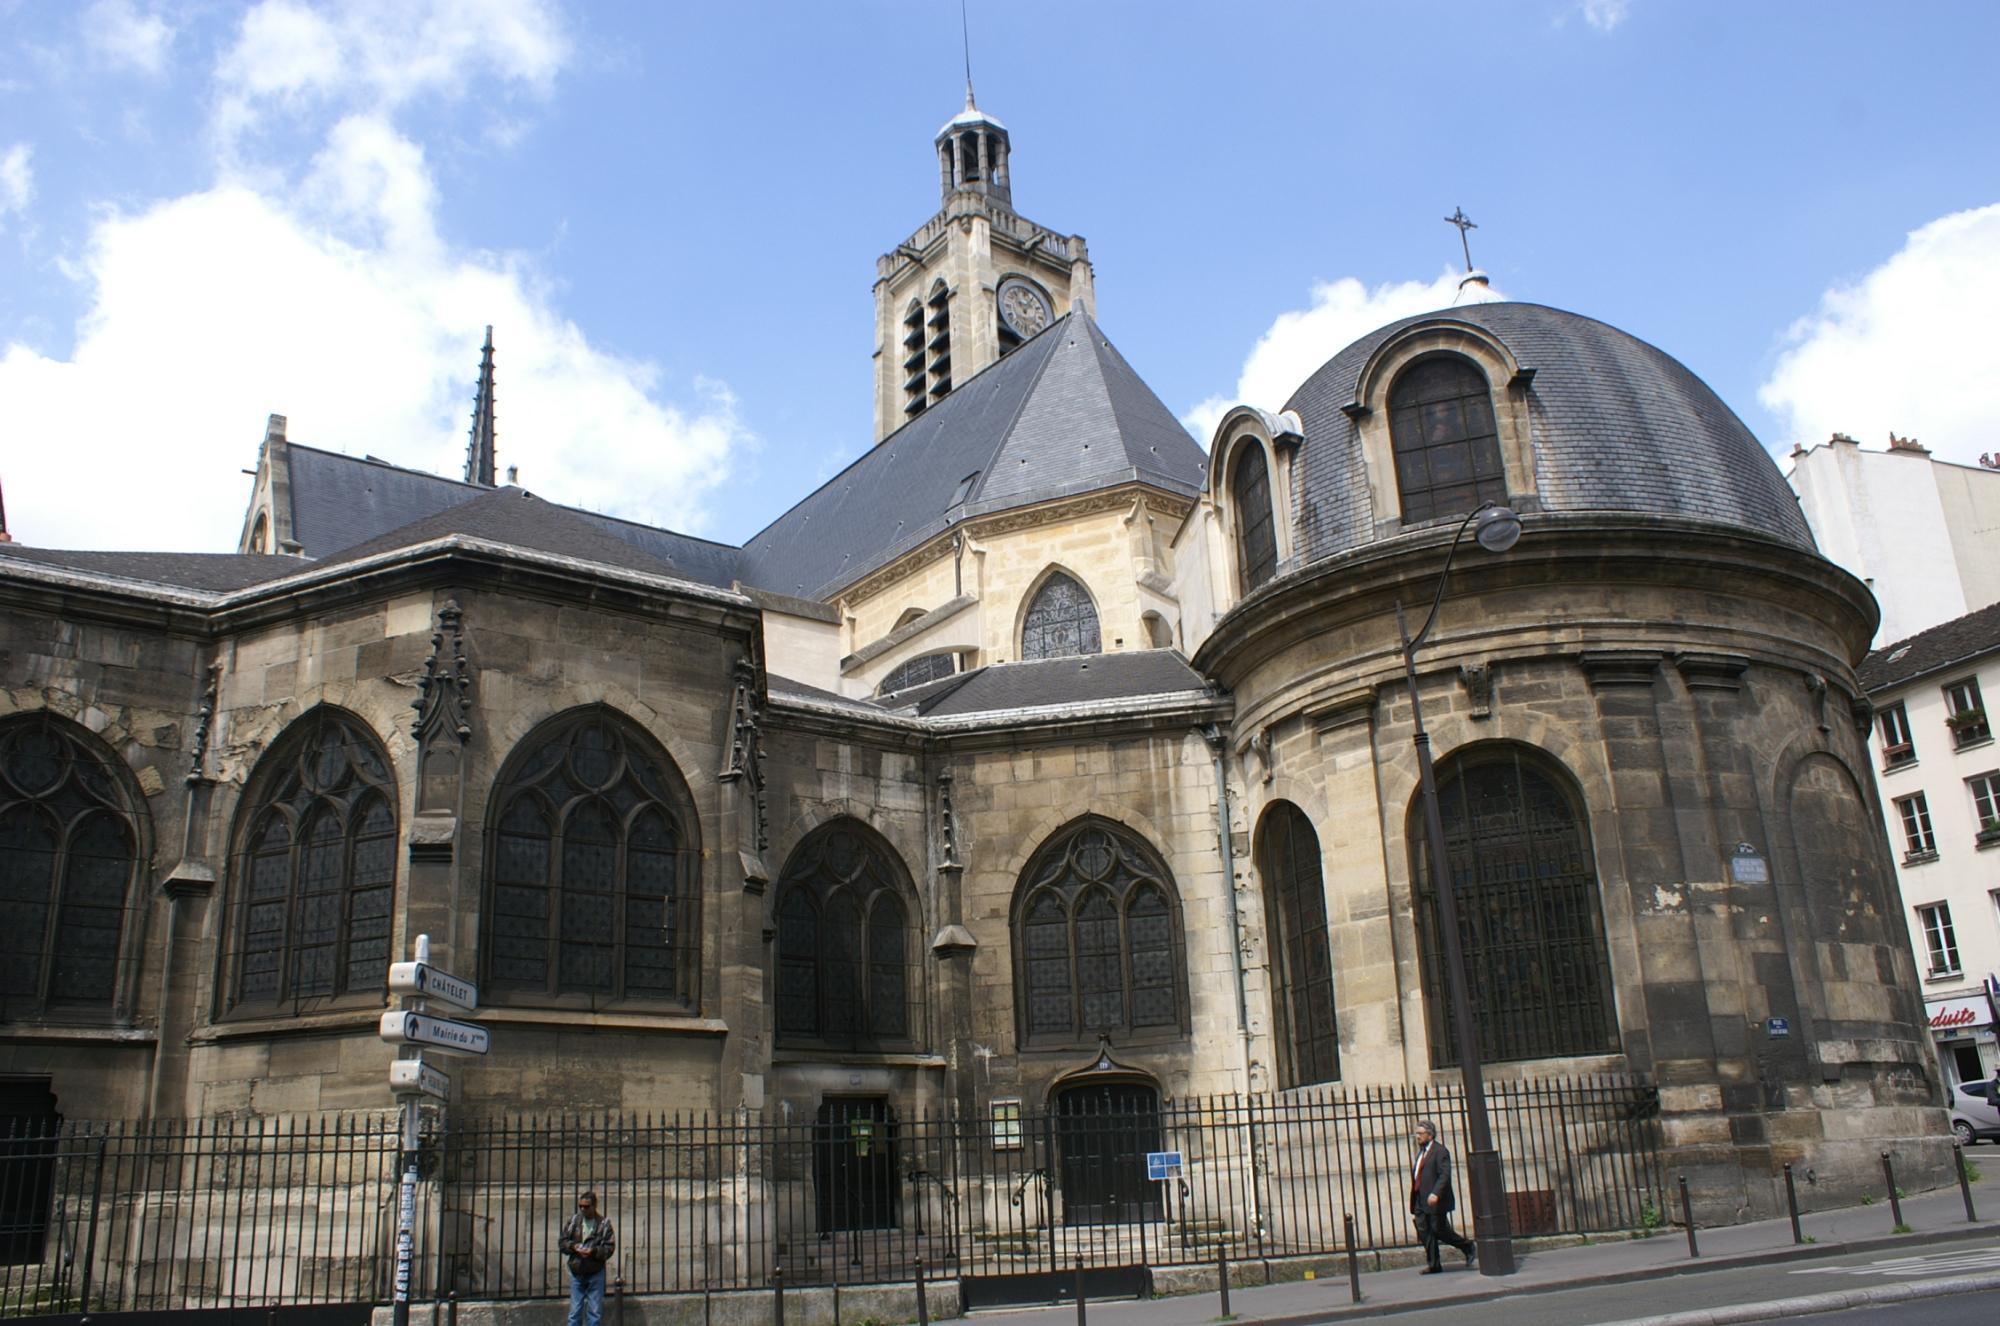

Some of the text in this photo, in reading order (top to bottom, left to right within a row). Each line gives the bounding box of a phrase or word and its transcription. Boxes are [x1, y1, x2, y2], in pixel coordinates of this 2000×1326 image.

[431, 976, 468, 1001] CHÂTELET
[432, 1024, 457, 1041] Mairie
[458, 1032, 468, 1044] du
